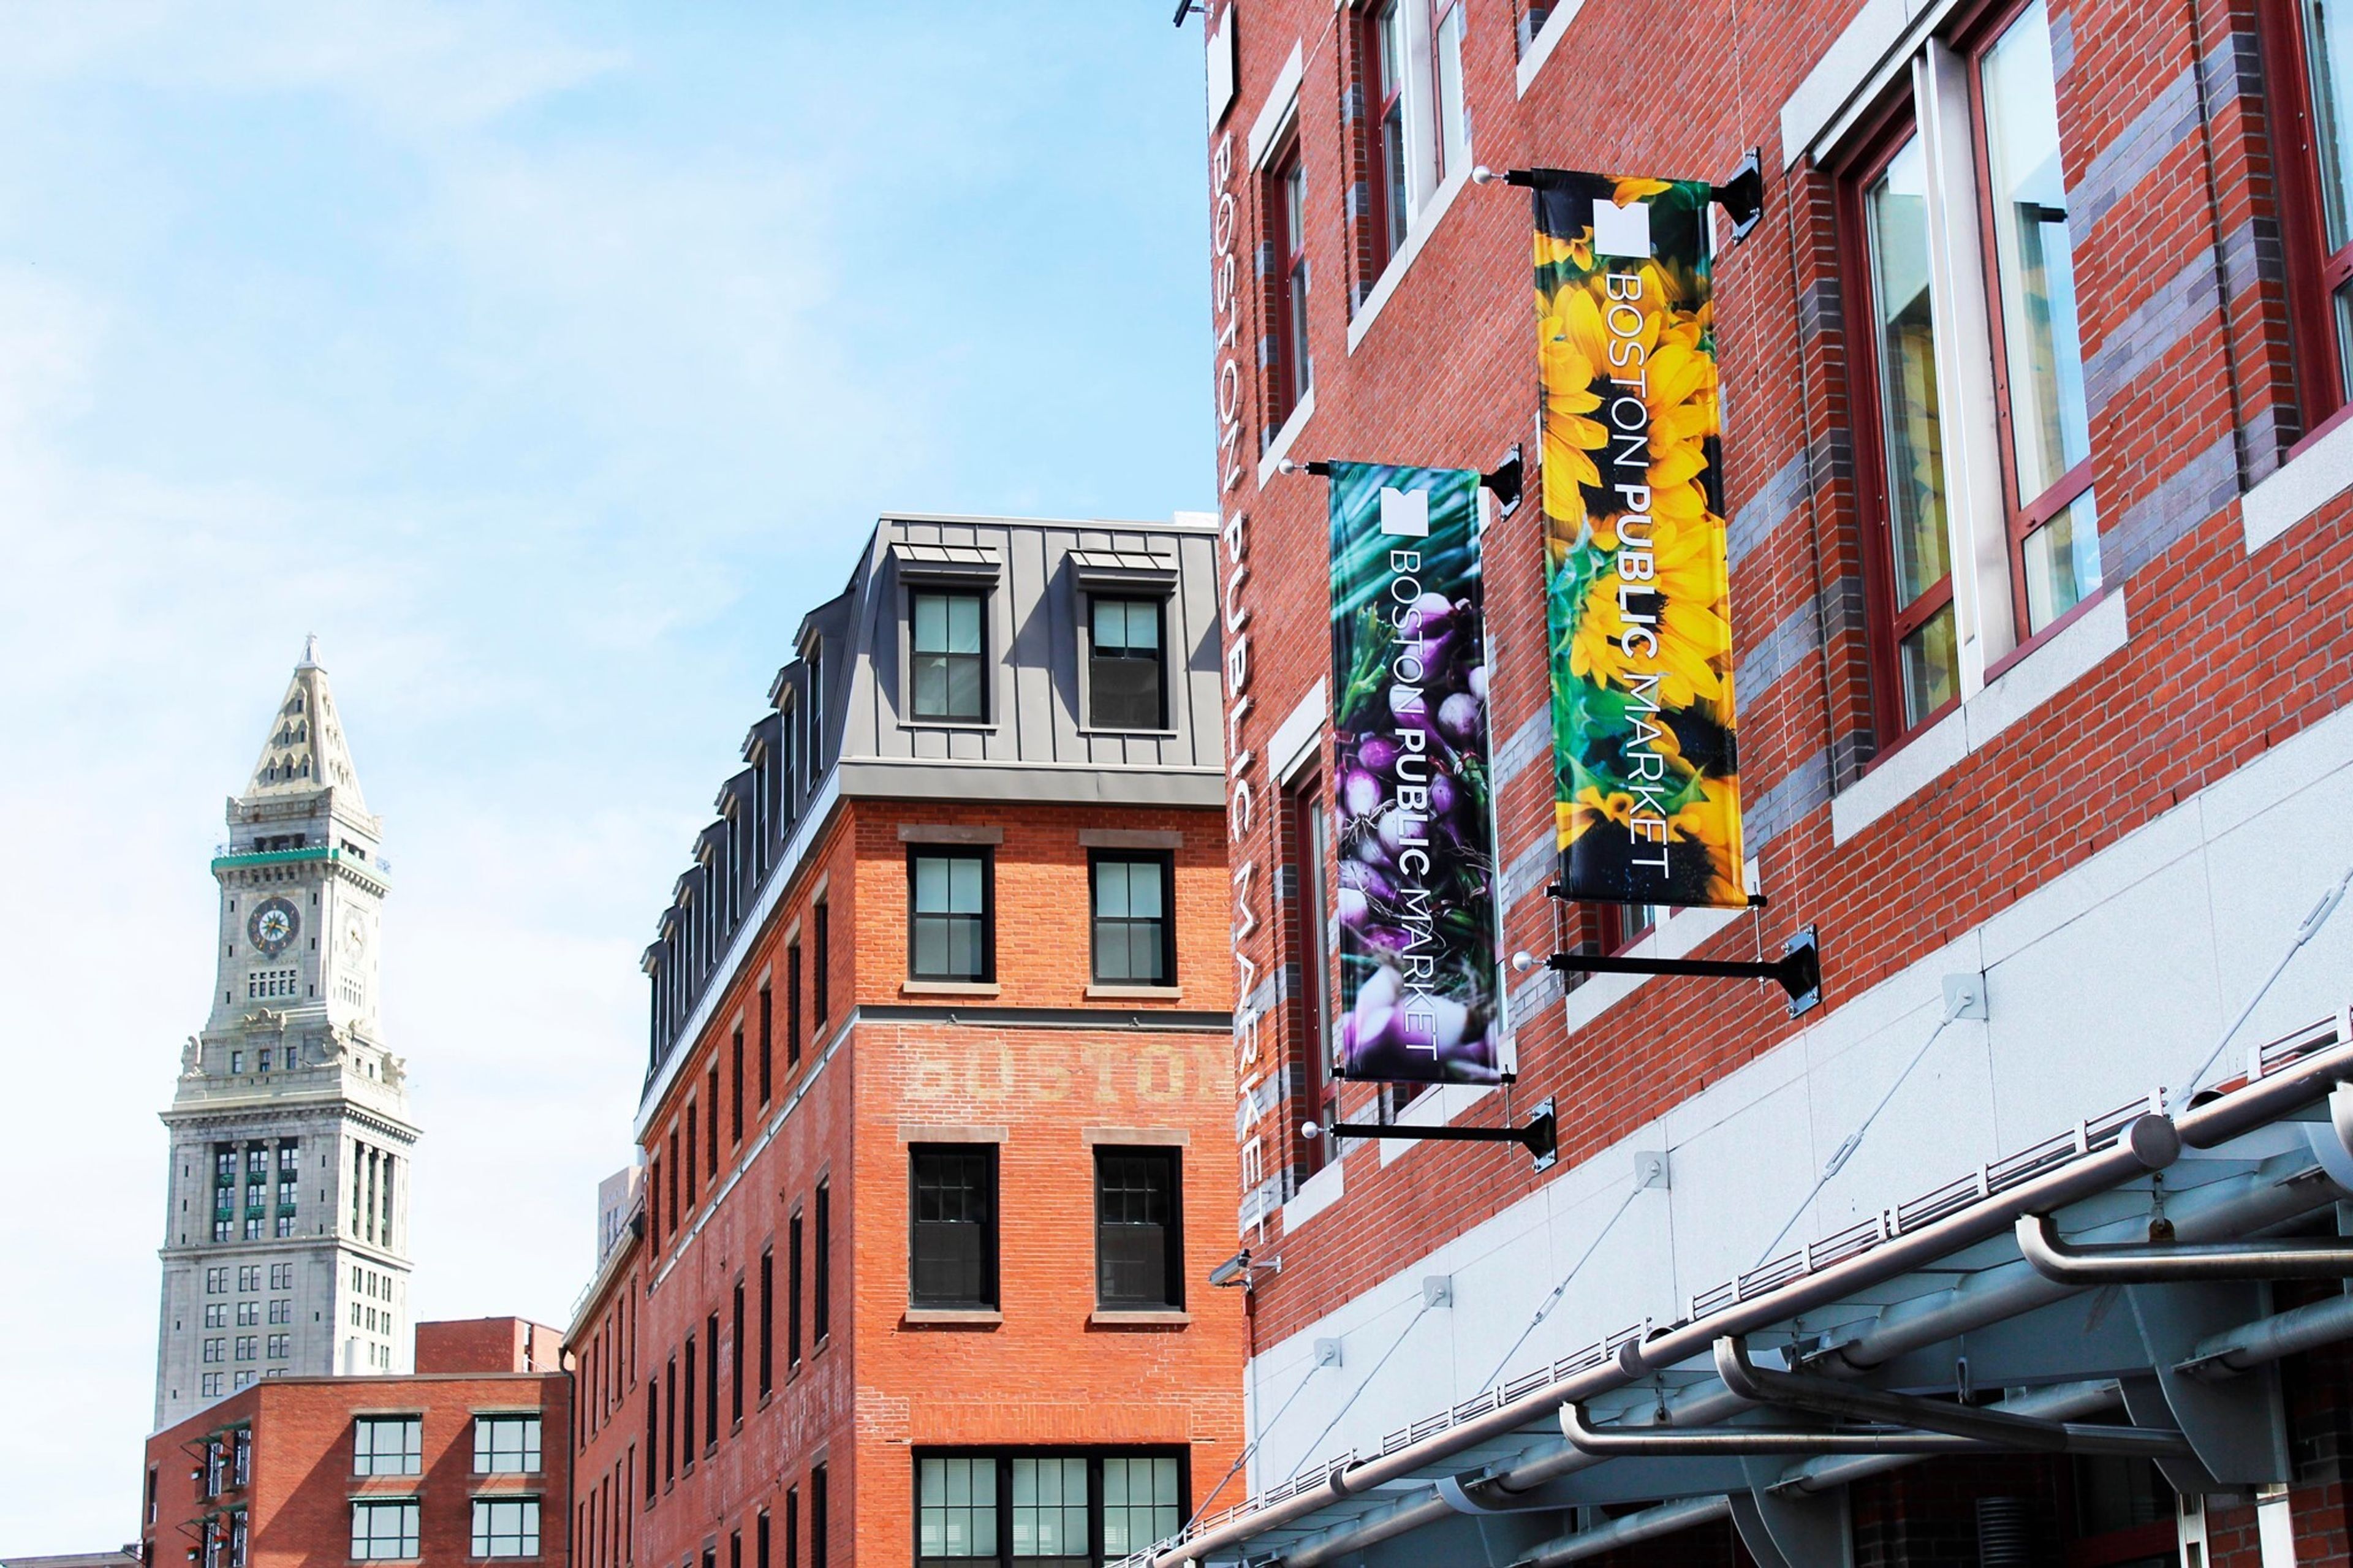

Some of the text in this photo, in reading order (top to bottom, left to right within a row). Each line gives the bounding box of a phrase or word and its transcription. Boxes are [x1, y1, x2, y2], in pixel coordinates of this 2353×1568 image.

[1214, 129, 1264, 1245] BOSTON PUBLIC MARKET
[1390, 550, 1438, 1061] BOSTON PUBLIC MARKET
[1605, 273, 1670, 879] BOSTON PUBLIC MARKET
